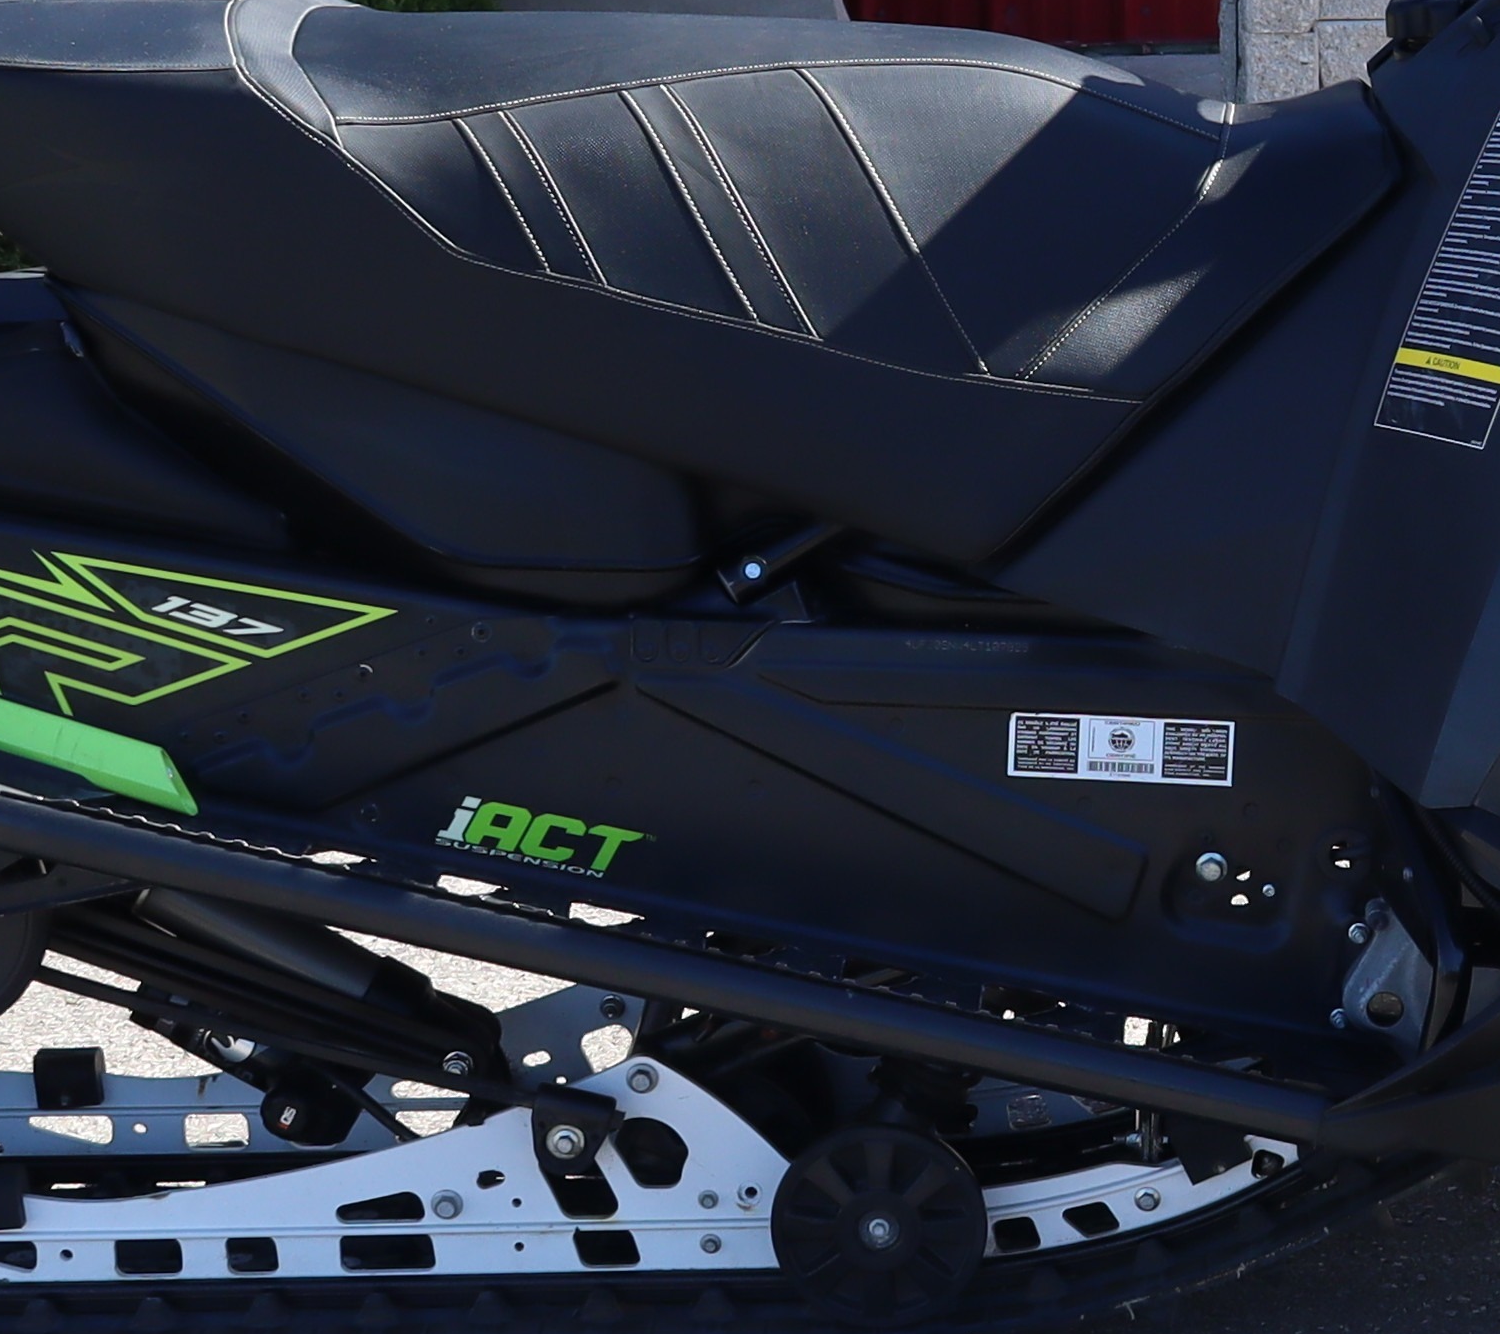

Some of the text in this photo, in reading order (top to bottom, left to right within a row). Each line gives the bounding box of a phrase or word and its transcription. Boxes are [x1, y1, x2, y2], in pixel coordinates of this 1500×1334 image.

[1431, 357, 1461, 370] CAUTION
[151, 595, 285, 636] 137
[436, 795, 645, 872] iACT
[434, 836, 605, 879] SUSPENSION
